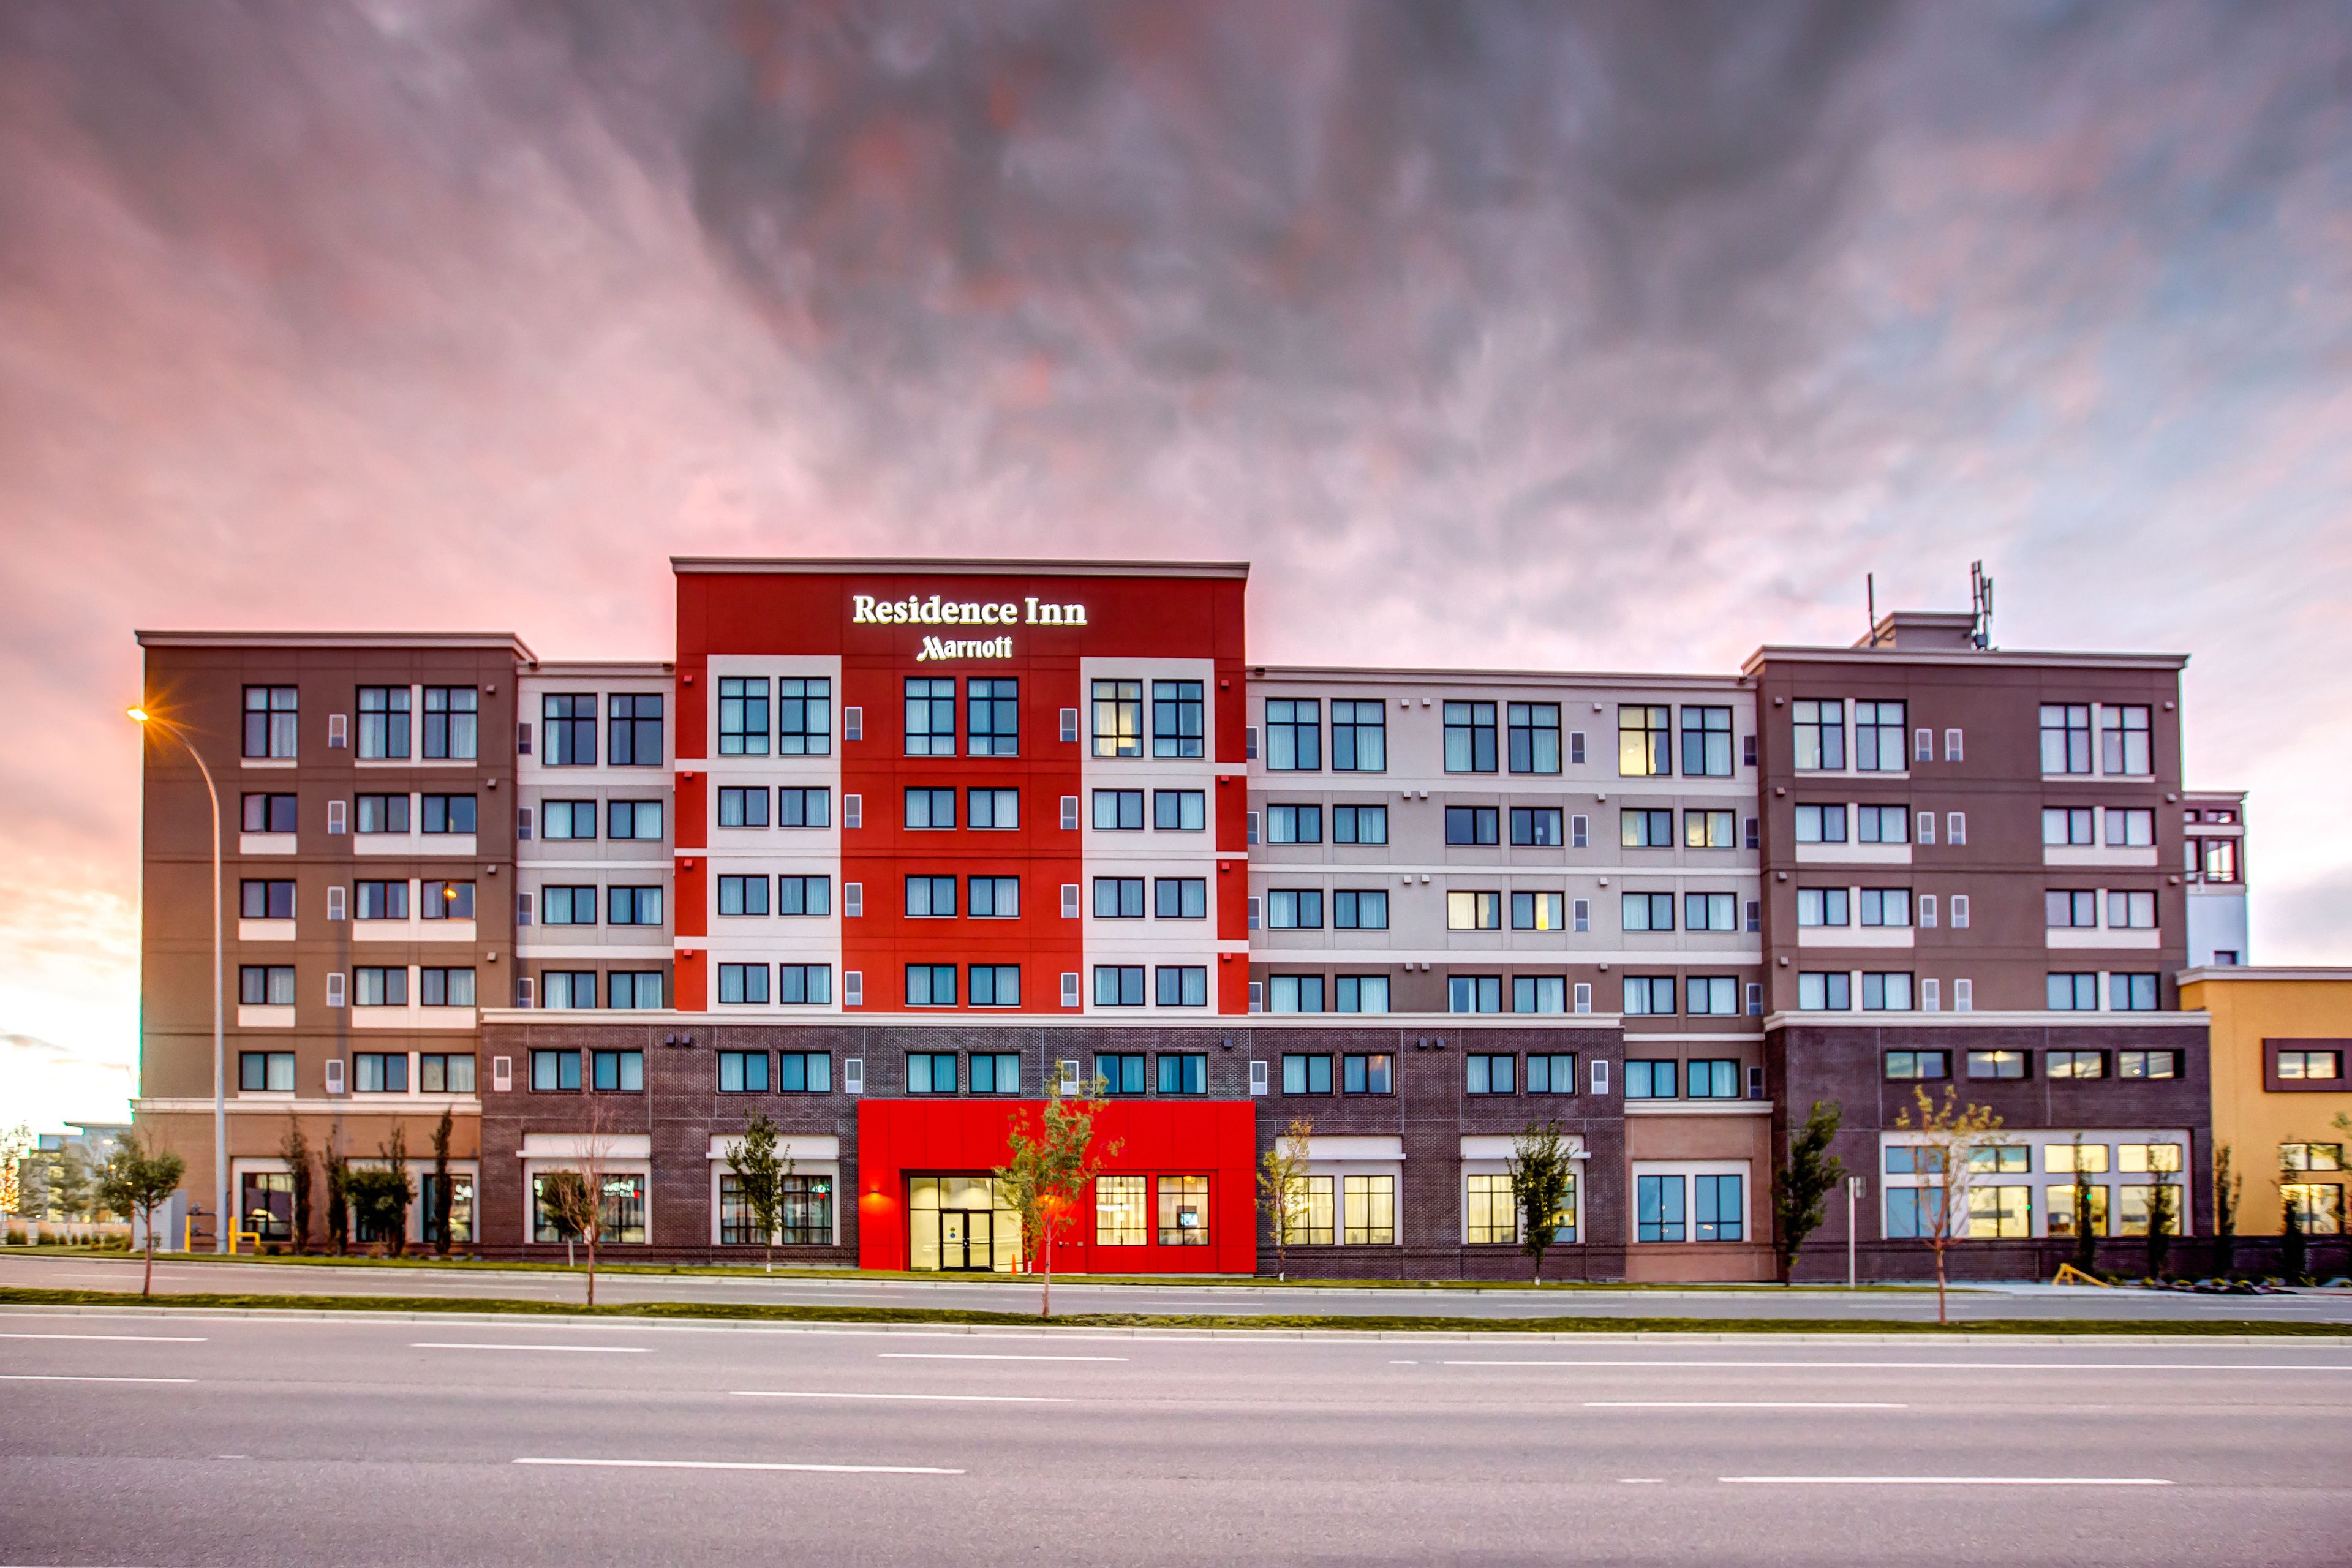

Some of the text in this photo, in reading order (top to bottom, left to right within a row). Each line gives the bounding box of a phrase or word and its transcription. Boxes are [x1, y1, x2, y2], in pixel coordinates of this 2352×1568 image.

[853, 595, 1088, 625] Residence Inn
[916, 636, 1013, 662] Marriott
